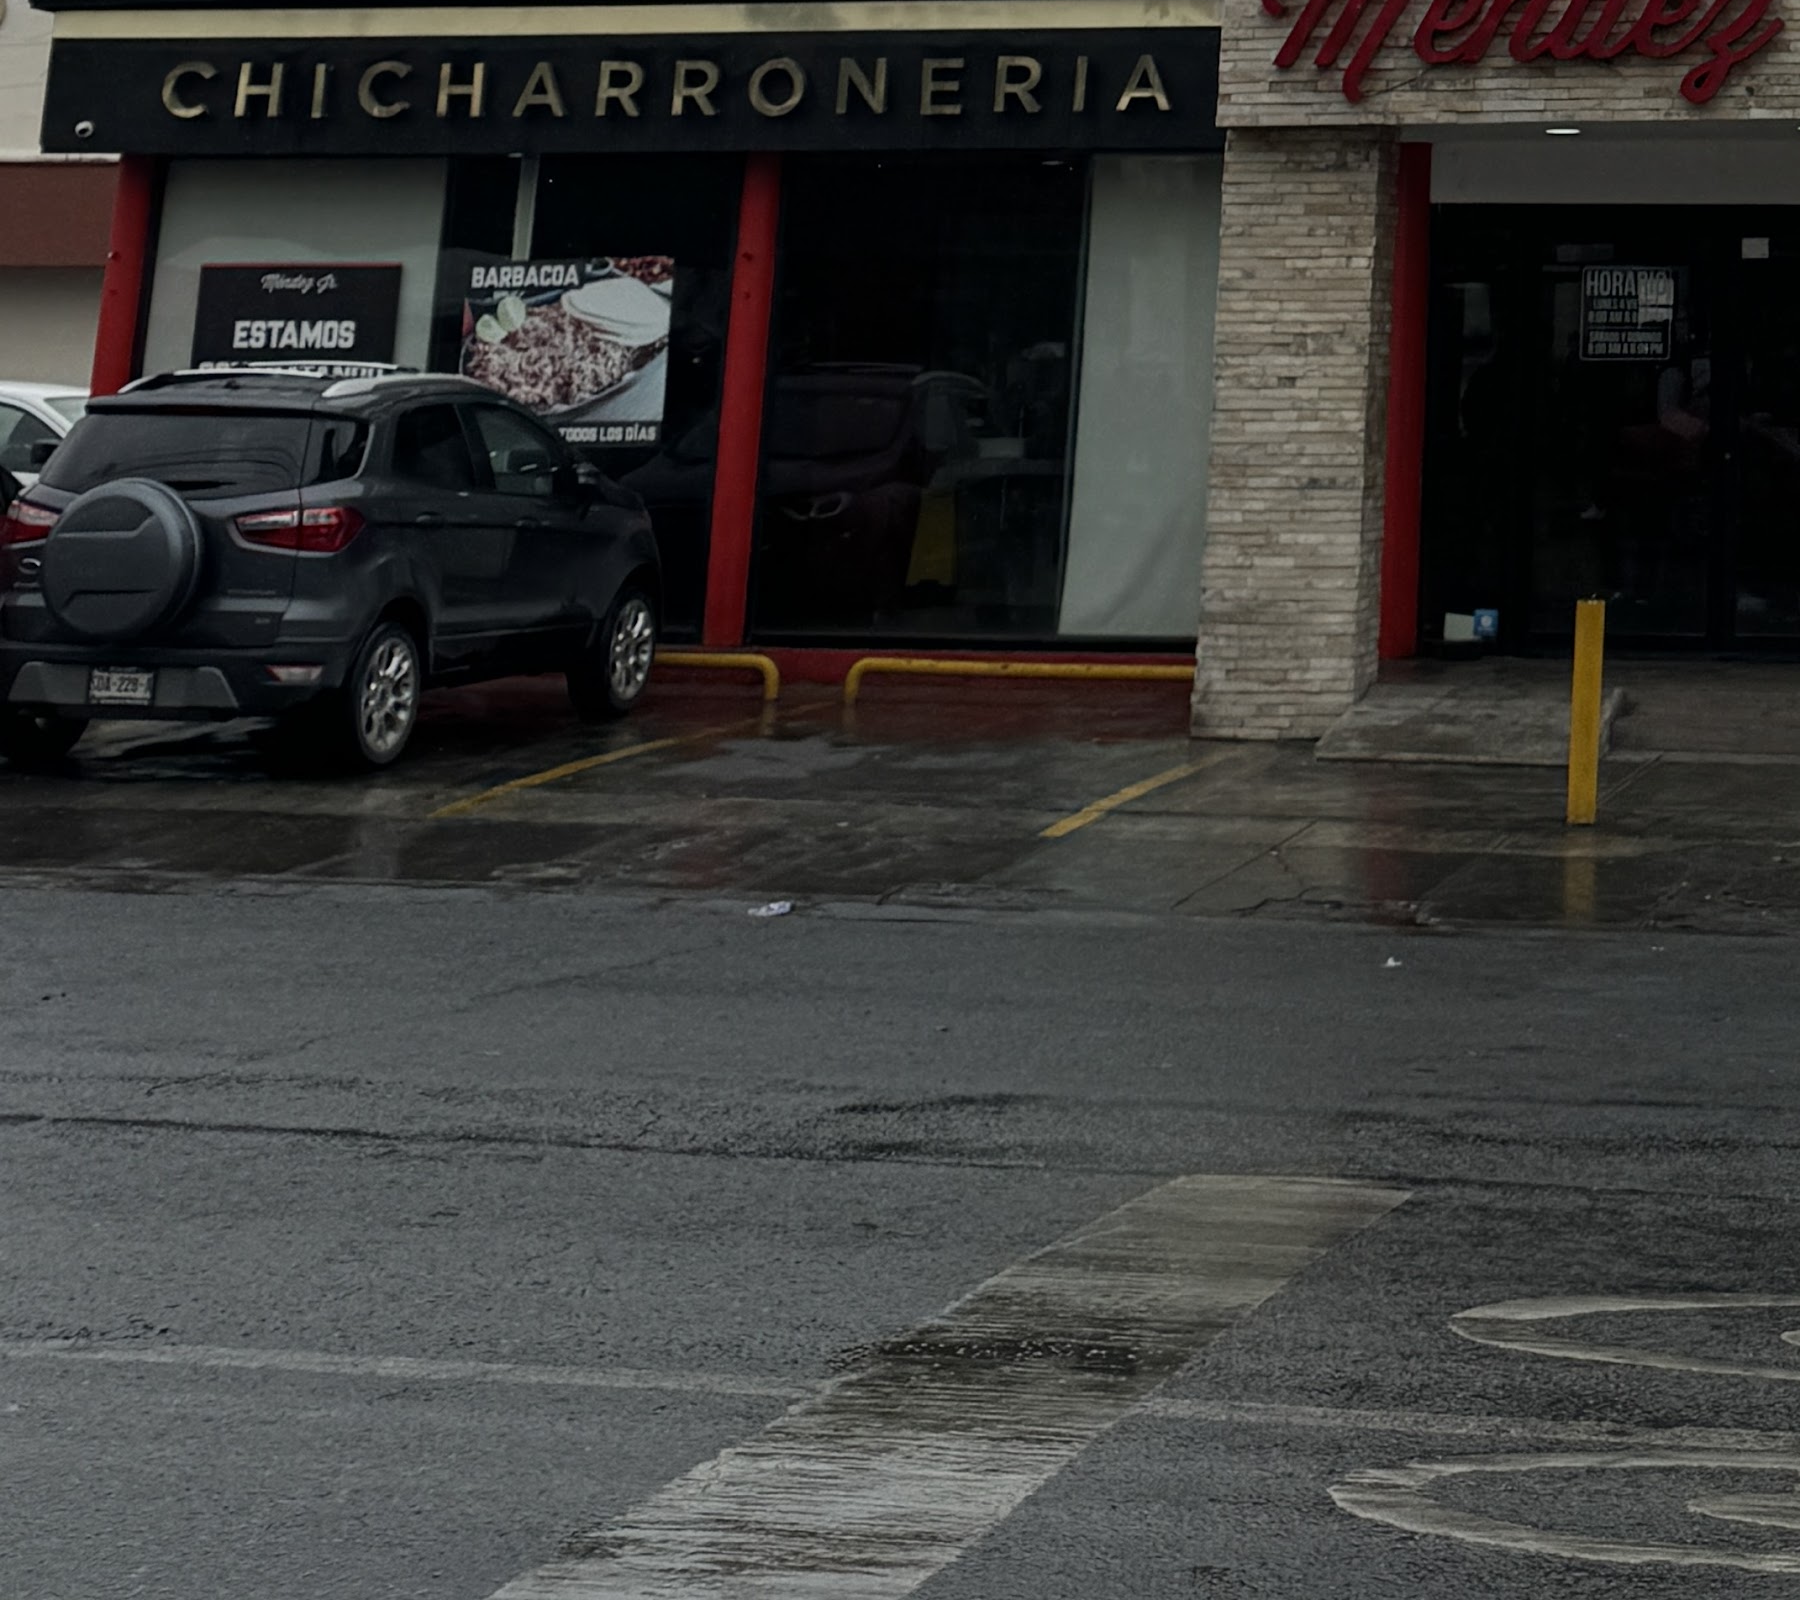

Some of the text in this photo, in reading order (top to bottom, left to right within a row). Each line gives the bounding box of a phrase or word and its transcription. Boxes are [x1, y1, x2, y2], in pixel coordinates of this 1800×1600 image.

[161, 53, 1172, 119] CHICHARRONERIA
[470, 264, 580, 289] BARBACOA
[232, 320, 356, 349] ESTAMOS
[599, 426, 623, 442] LOS
